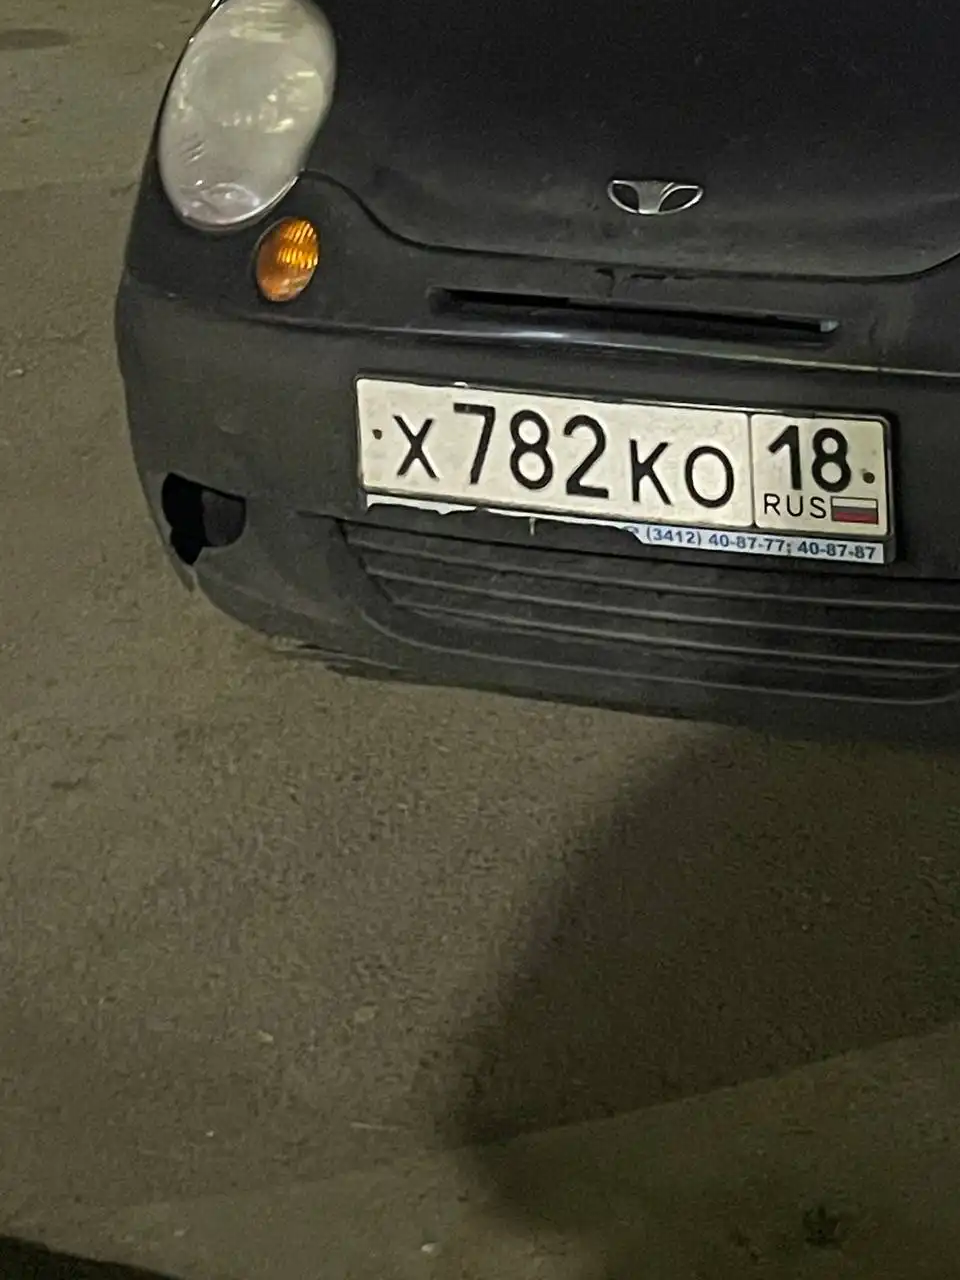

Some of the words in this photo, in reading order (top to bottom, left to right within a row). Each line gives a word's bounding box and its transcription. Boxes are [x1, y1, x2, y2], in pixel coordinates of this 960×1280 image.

[767, 424, 852, 493] 18
[763, 493, 828, 518] RUS
[646, 525, 702, 546] (3412)
[796, 540, 877, 560] 40-87-87
